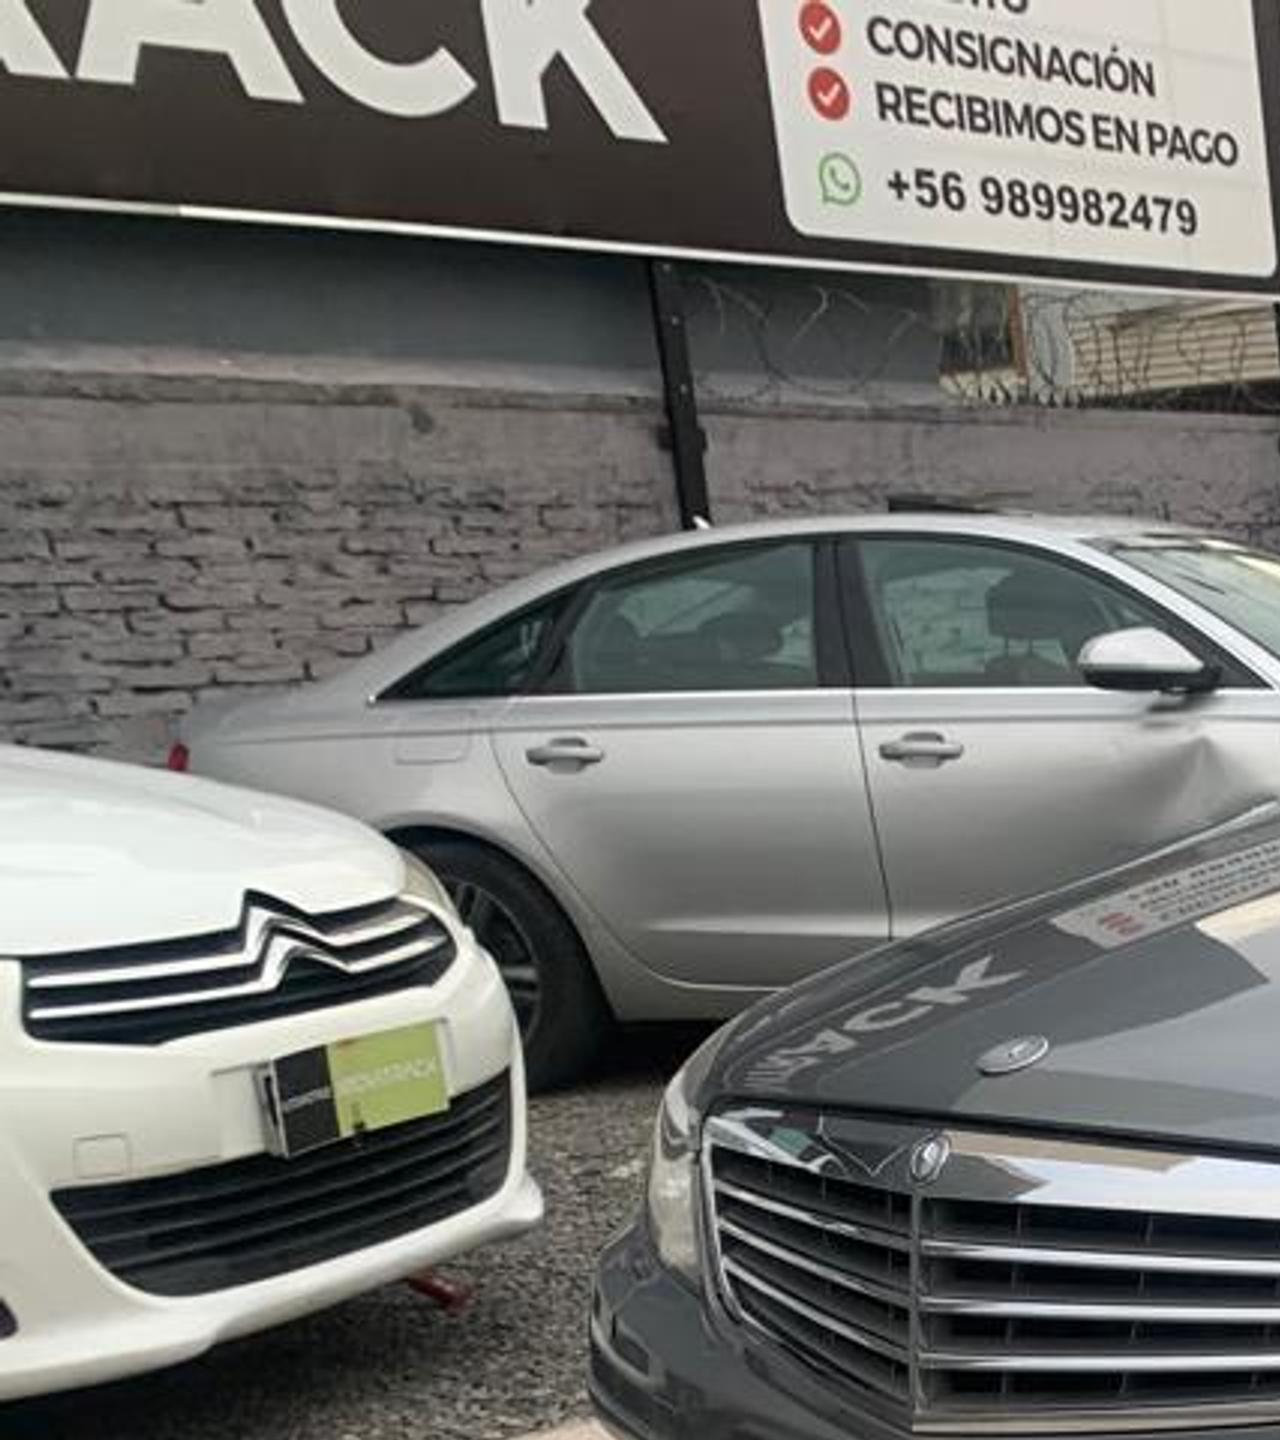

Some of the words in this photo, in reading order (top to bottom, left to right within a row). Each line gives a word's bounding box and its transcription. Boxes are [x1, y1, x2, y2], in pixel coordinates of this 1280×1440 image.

[866, 16, 1156, 97] CONSIGNACIÓN
[874, 81, 1087, 146] RECIBIMOS
[1091, 114, 1139, 157] EN
[1147, 121, 1239, 168] PAGO
[886, 168, 967, 211] +56
[980, 176, 1198, 236] 989982479
